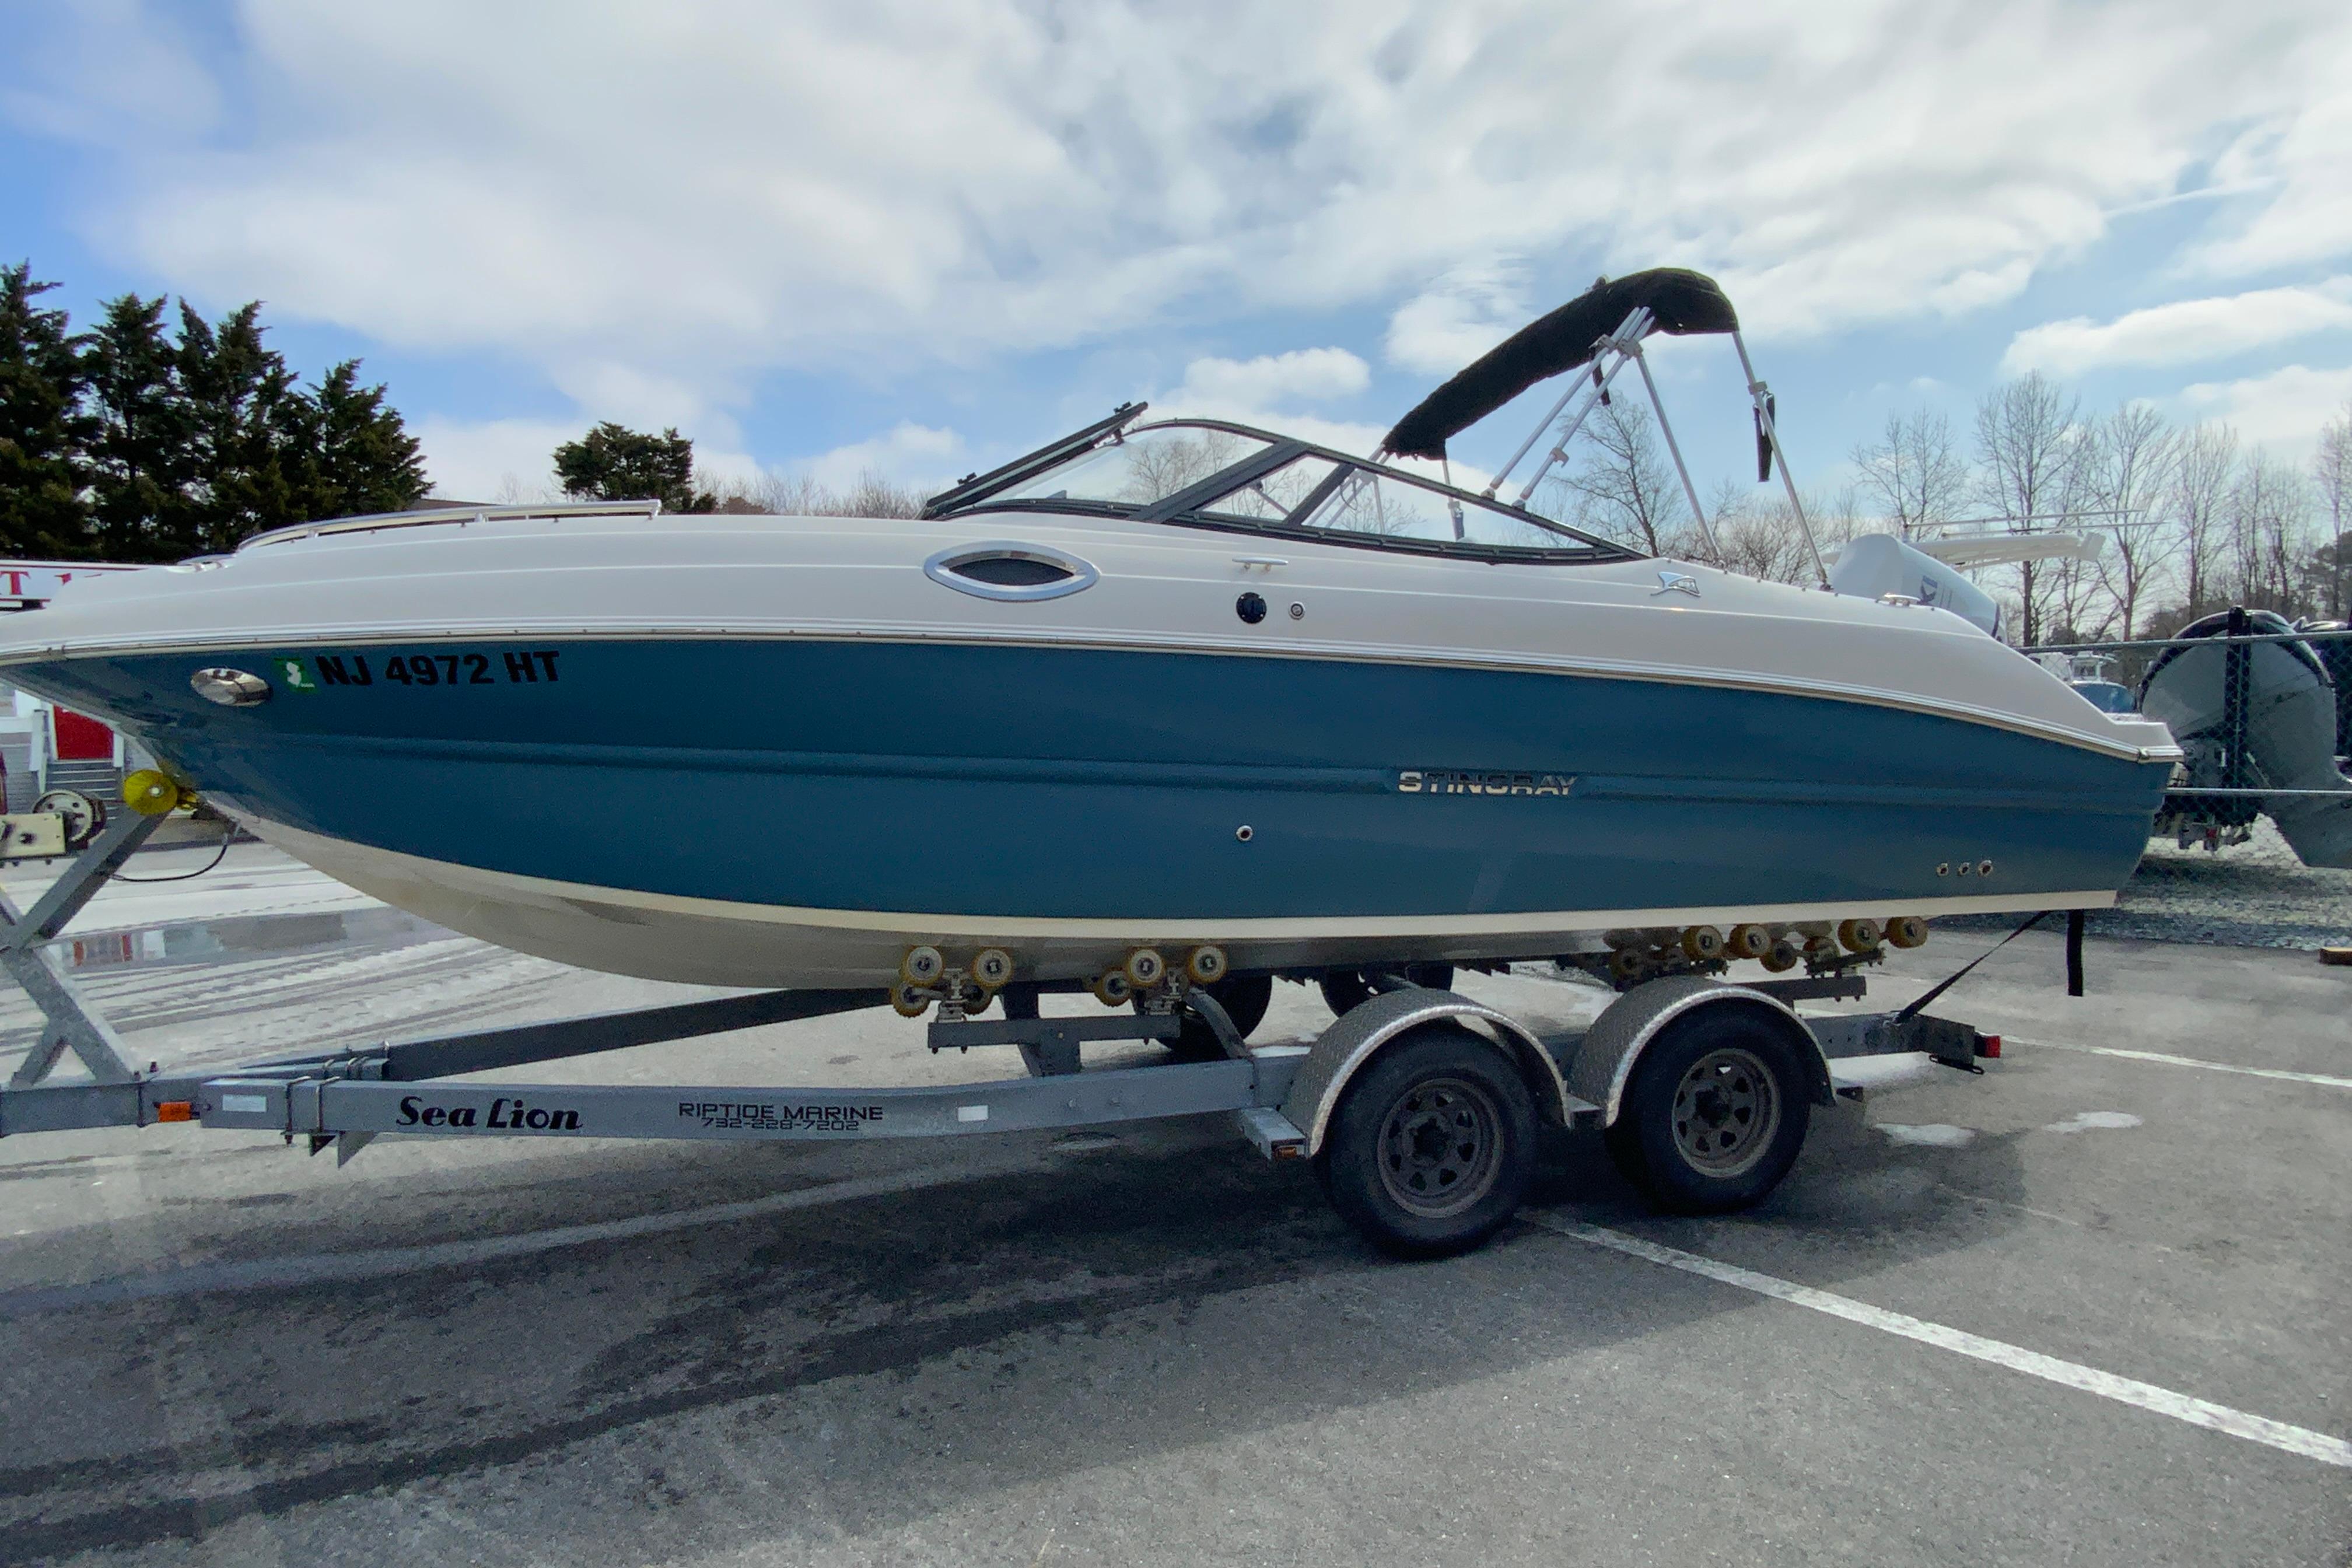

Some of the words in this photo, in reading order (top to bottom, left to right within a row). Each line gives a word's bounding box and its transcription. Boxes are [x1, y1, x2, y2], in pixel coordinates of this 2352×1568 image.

[316, 655, 372, 685] NJ
[385, 654, 494, 685] 4972
[503, 650, 559, 682] HT
[1398, 771, 1577, 795] STINGRAY
[396, 1096, 476, 1127] Sea
[487, 1098, 583, 1130] Lion
[678, 1102, 774, 1119] RIPTIDE
[783, 1105, 883, 1121] MARINE
[701, 1118, 859, 1130] 732-228-7202
